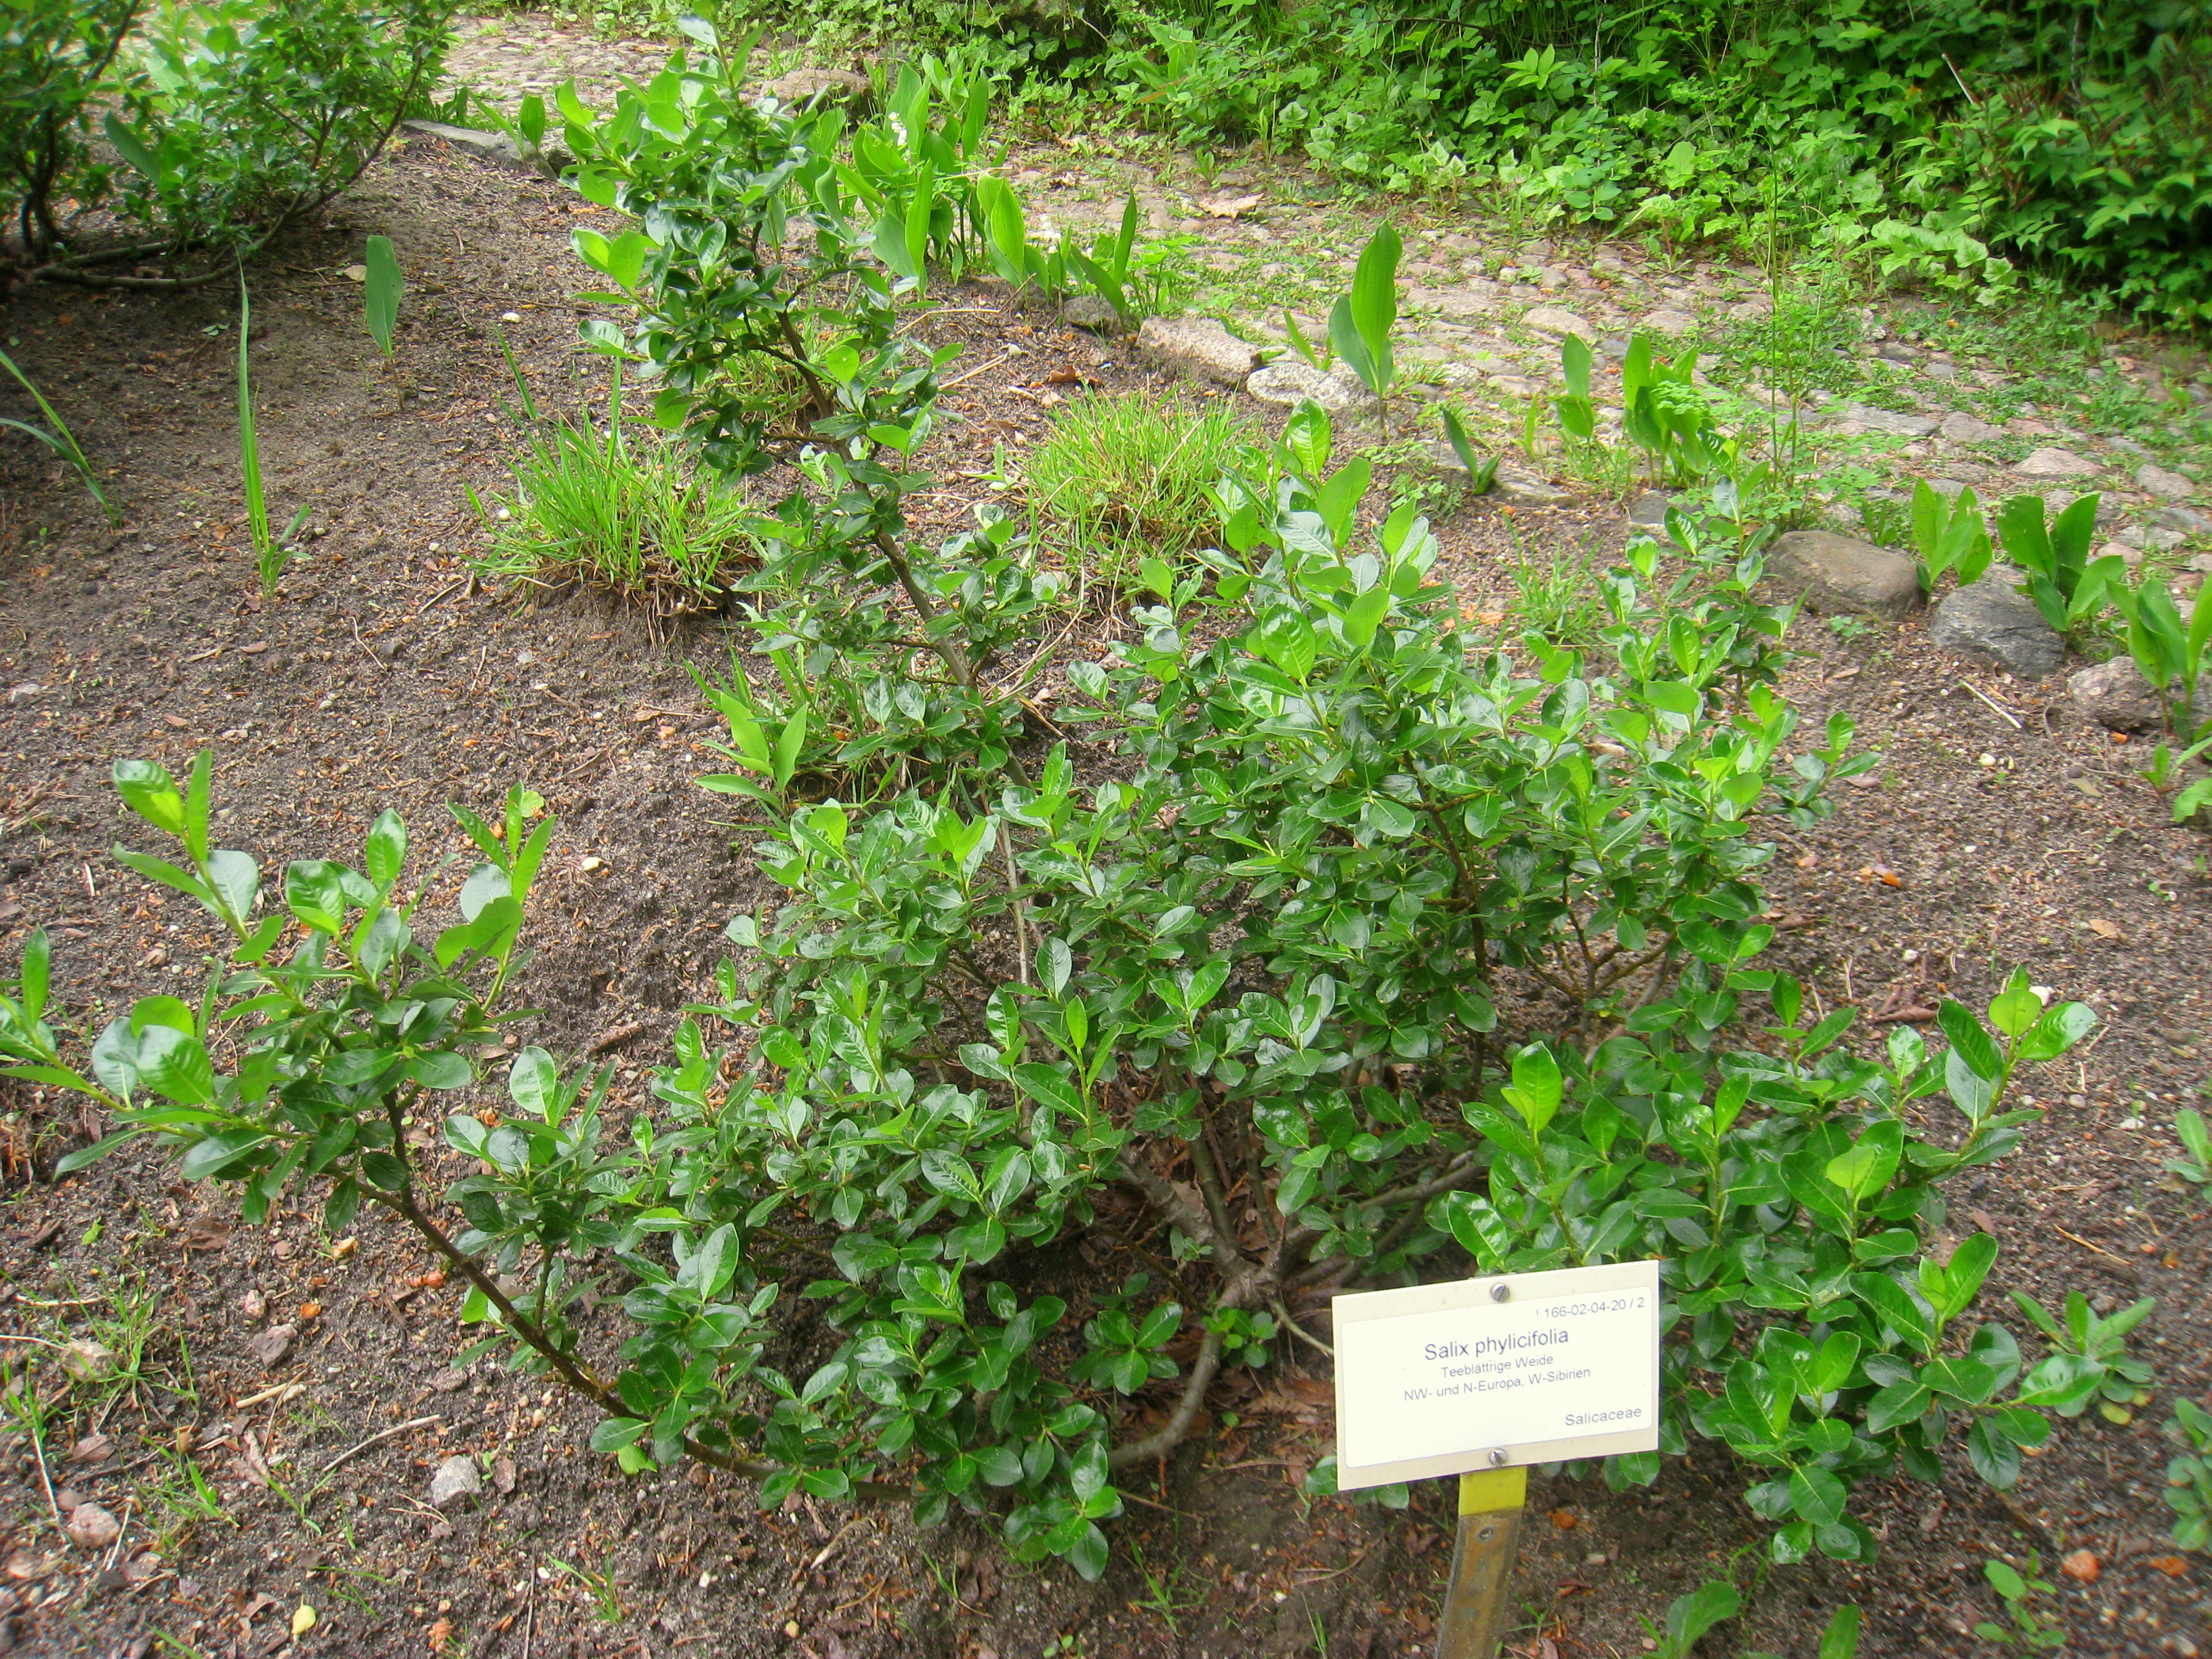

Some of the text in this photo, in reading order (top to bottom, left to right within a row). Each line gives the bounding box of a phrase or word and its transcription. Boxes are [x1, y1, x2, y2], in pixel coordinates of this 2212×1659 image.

[1544, 1298, 1626, 1319] 166-02-04-20
[1637, 1297, 1645, 1308] 2
[1425, 1328, 1569, 1360] Salix phylicifolia
[1441, 1353, 1554, 1378] Teeblättrige Weide
[1404, 1367, 1591, 1401] NW- und N-Europa, W-Sibirien
[1565, 1406, 1642, 1426] Salicaceae
